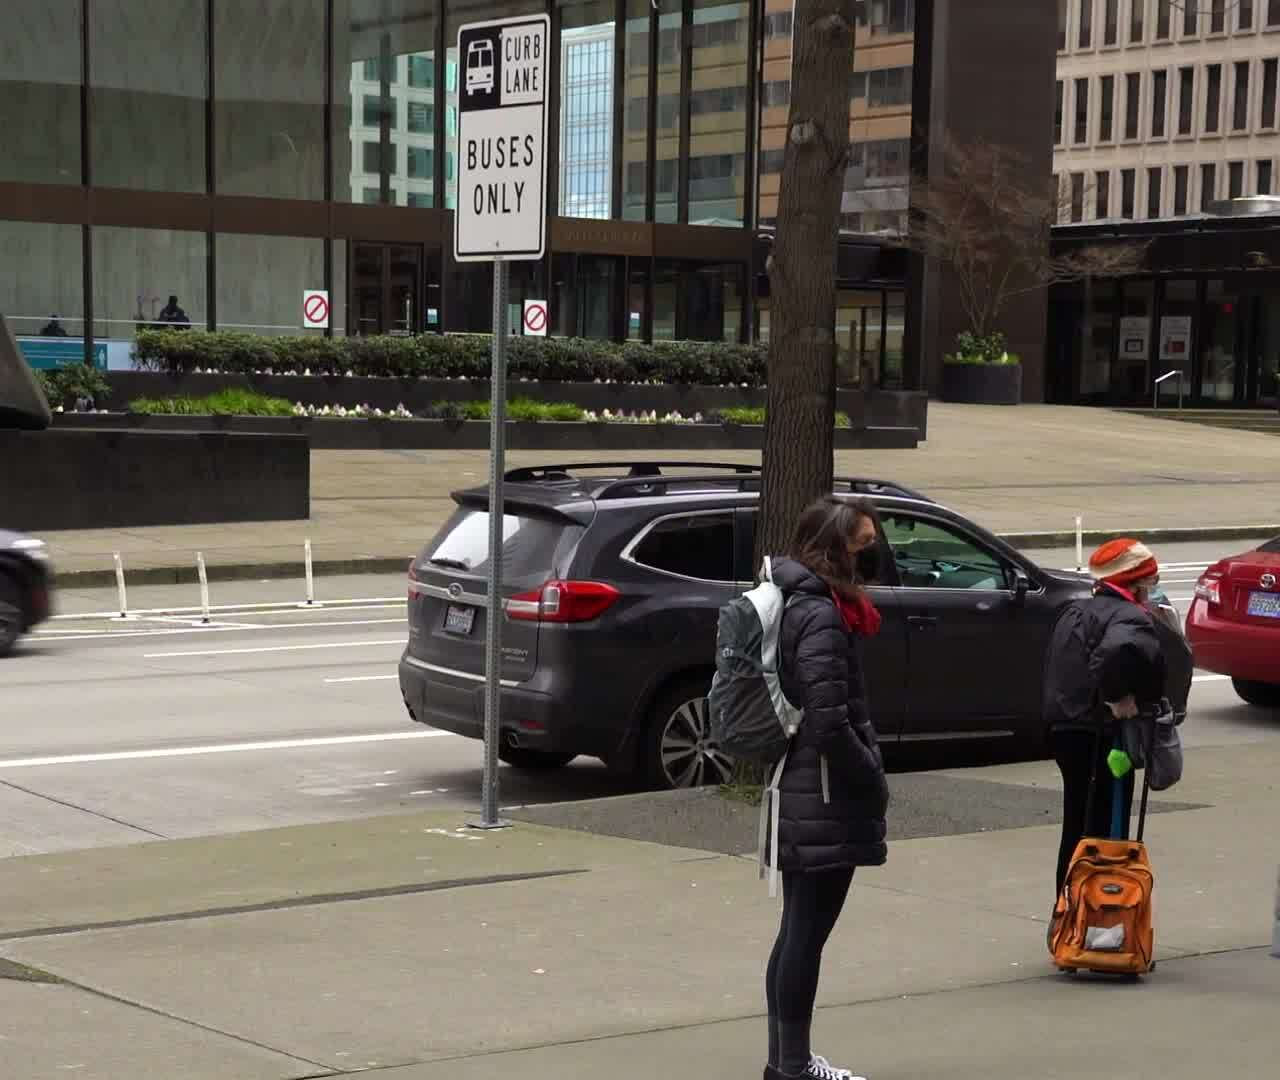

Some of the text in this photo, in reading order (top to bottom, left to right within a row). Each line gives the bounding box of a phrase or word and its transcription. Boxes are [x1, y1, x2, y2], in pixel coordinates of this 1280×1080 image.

[505, 34, 541, 62] CURB
[505, 66, 539, 93] LANE
[467, 134, 534, 170] BUSES
[473, 181, 525, 215] ONLY
